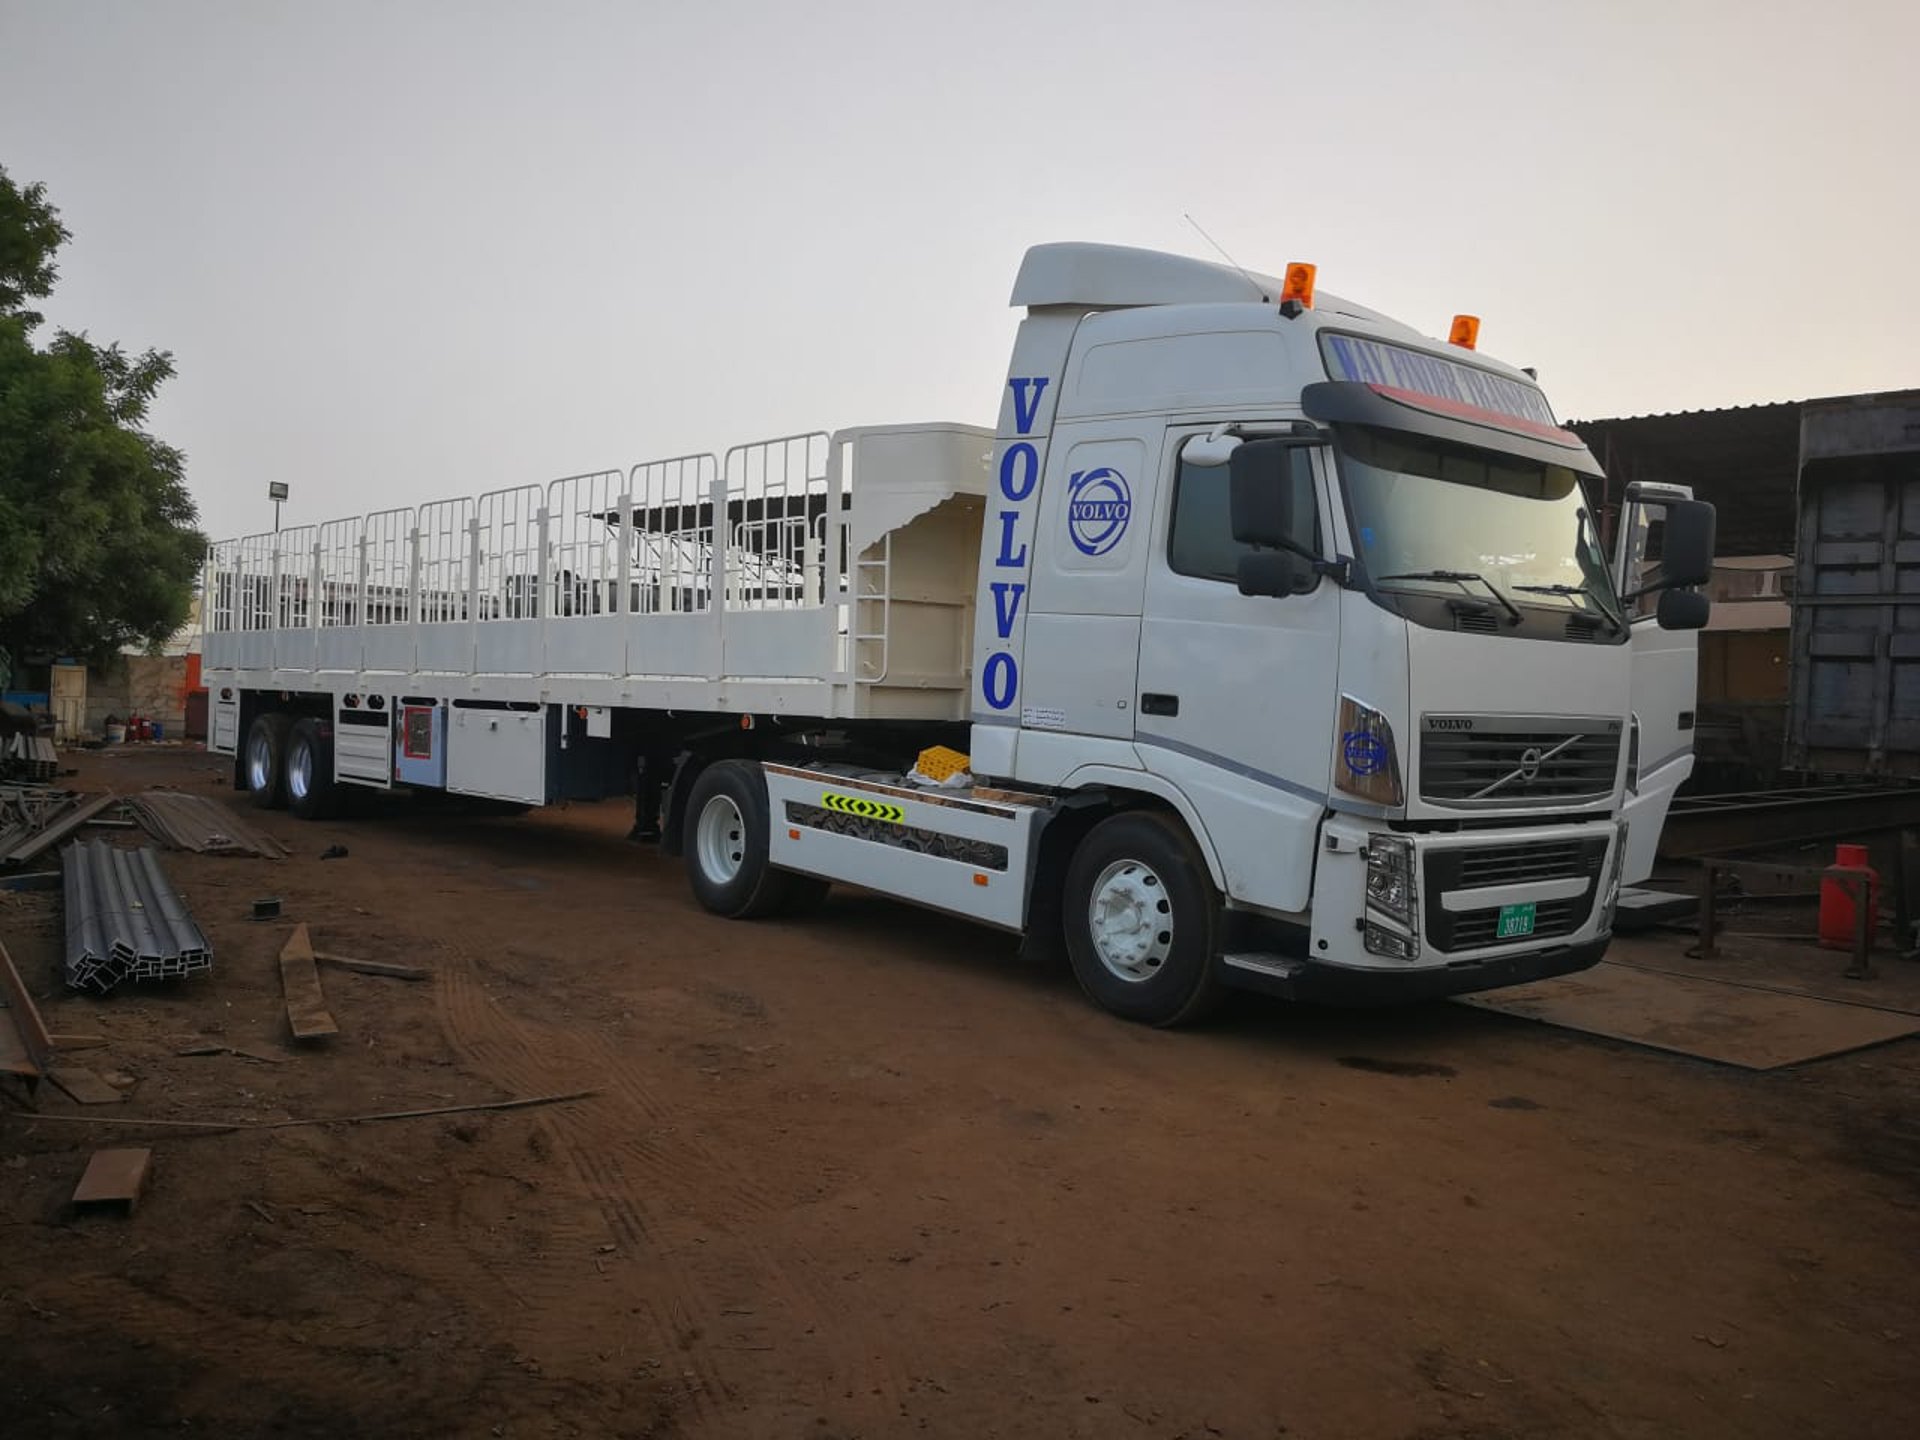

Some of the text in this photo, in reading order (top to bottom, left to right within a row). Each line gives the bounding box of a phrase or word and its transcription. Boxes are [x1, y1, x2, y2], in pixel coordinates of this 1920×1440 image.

[1072, 503, 1129, 520] VOLVO
[982, 377, 1049, 710] VOLVO
[1428, 719, 1472, 730] VOLVO
